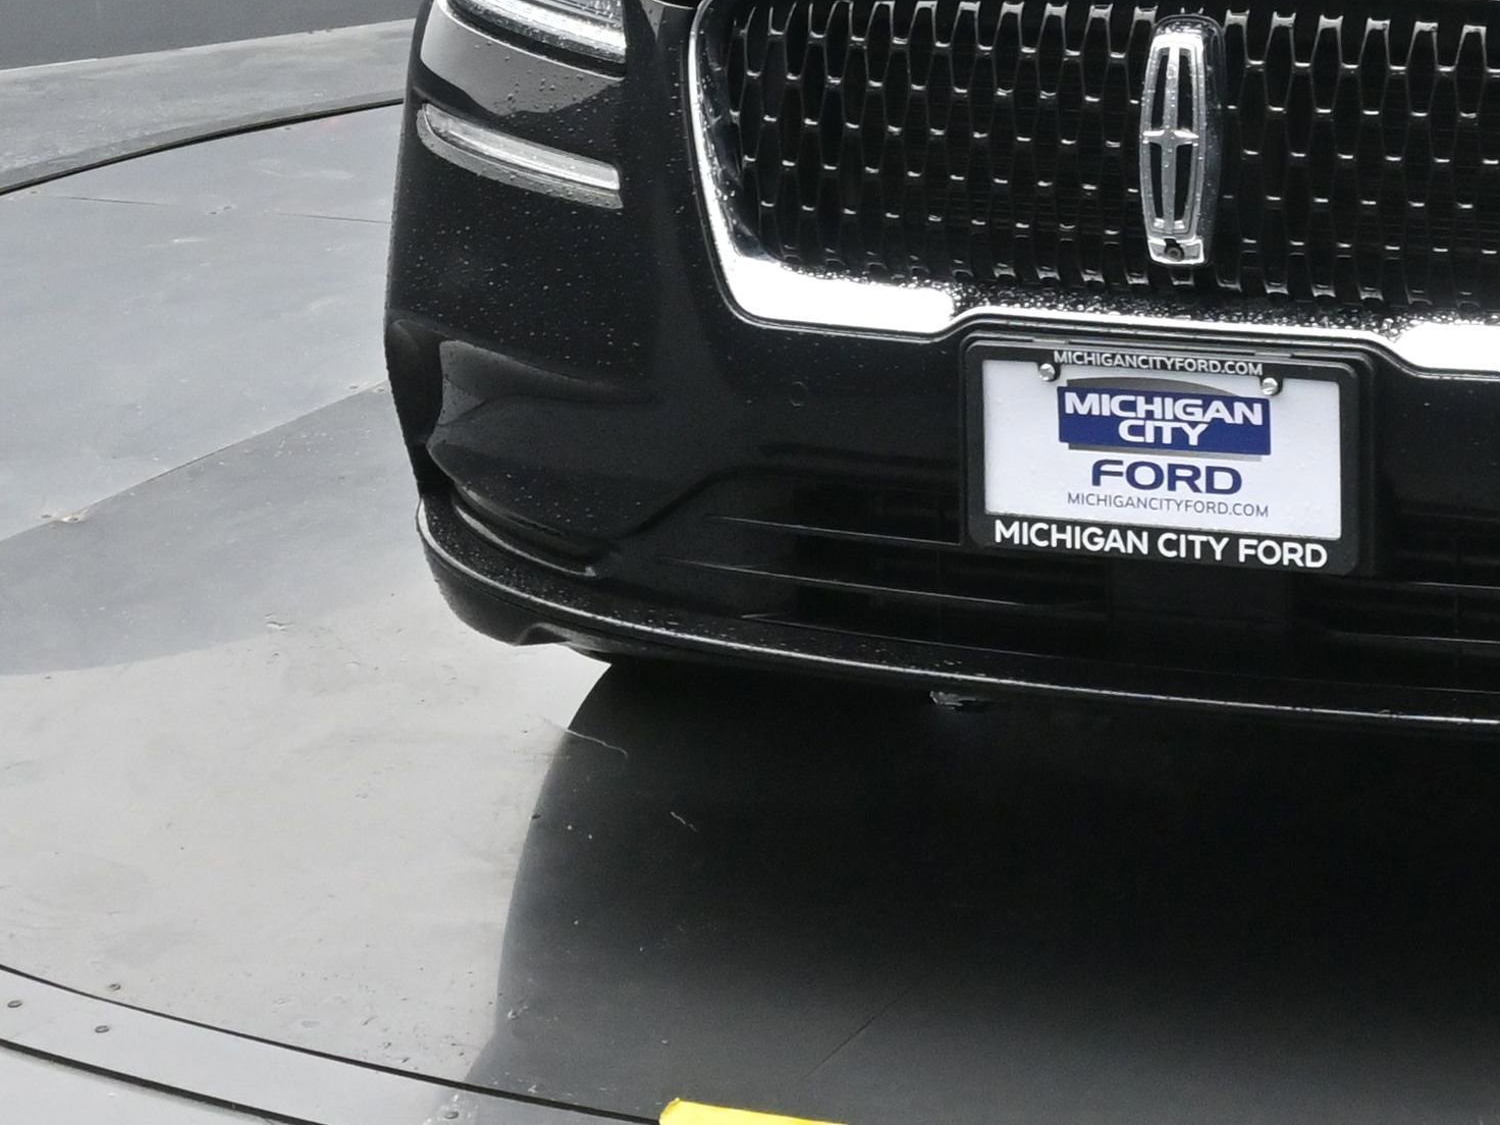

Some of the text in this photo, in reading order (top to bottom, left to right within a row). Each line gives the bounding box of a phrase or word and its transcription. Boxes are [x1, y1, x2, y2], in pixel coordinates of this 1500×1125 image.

[1053, 350, 1263, 376] MICHIGANCITYFORD.COM
[1064, 391, 1263, 426] MICHIGAN
[1118, 419, 1209, 446] CITY
[1092, 459, 1242, 495] FORD
[1067, 492, 1269, 518] MICHIGANCITYFORD.COM
[995, 520, 1328, 569] MICHIGAN CITY FORD
